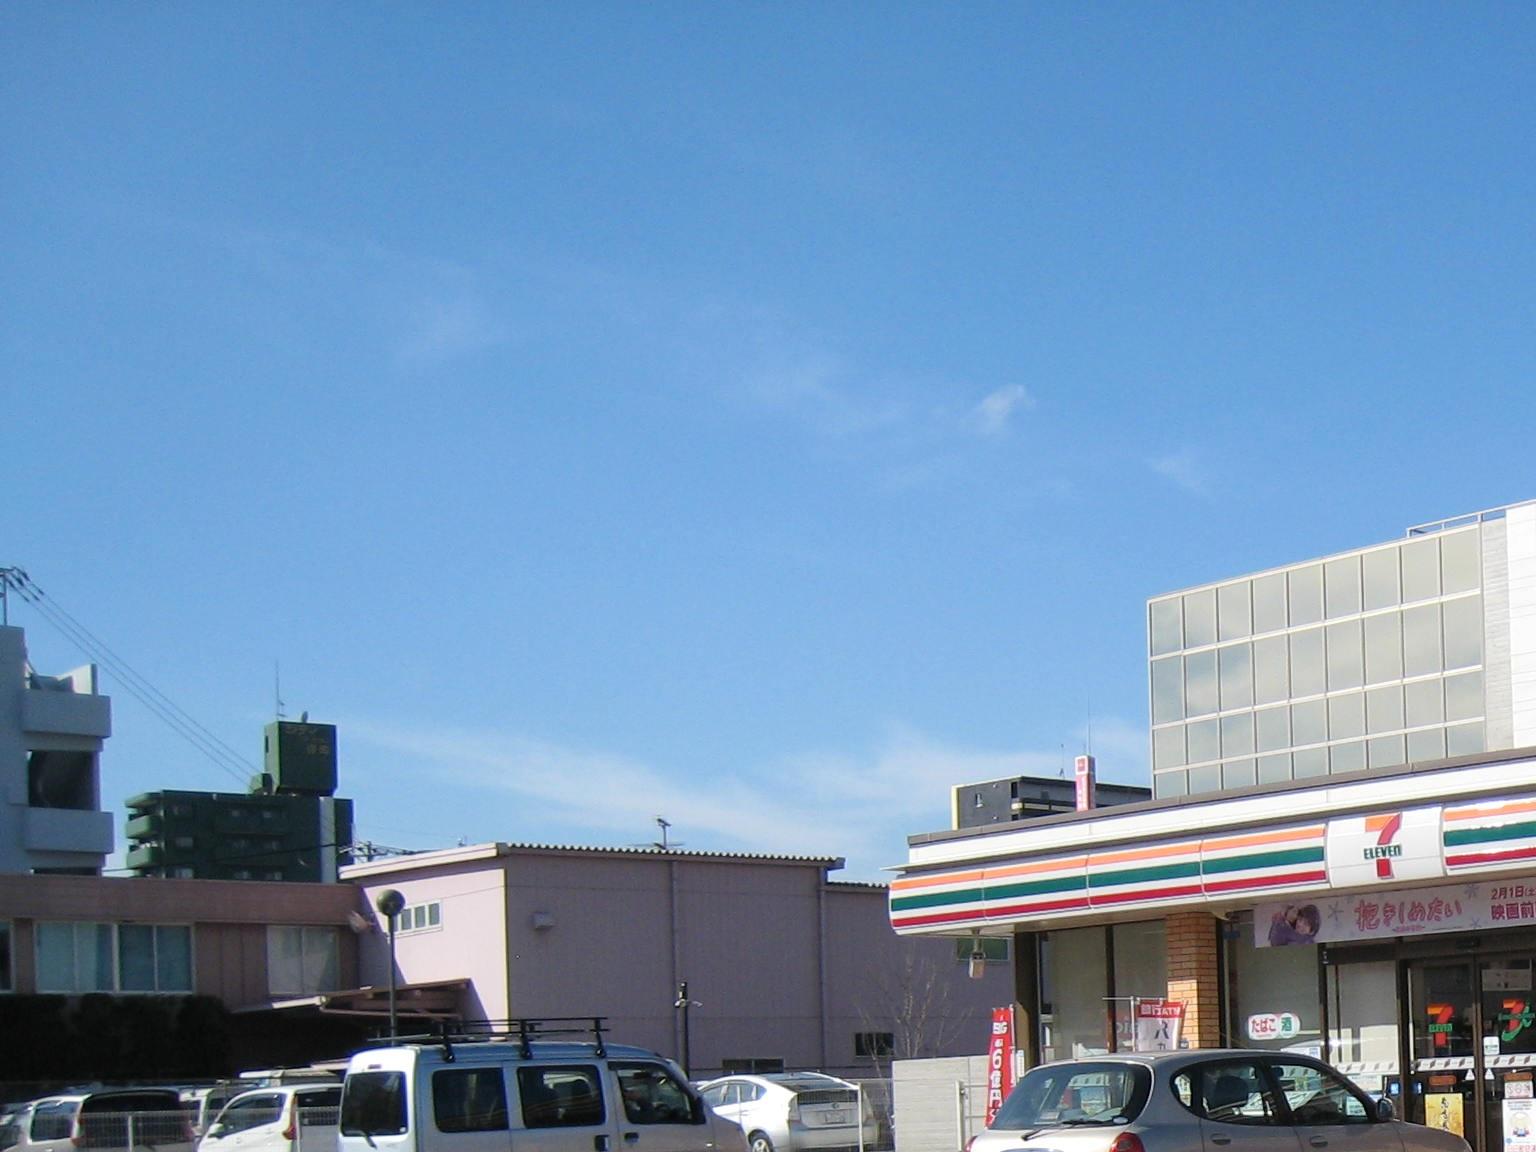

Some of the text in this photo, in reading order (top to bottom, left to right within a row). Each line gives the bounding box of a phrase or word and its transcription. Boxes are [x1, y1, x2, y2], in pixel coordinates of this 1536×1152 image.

[1251, 1016, 1293, 1033] たばこ 酒
